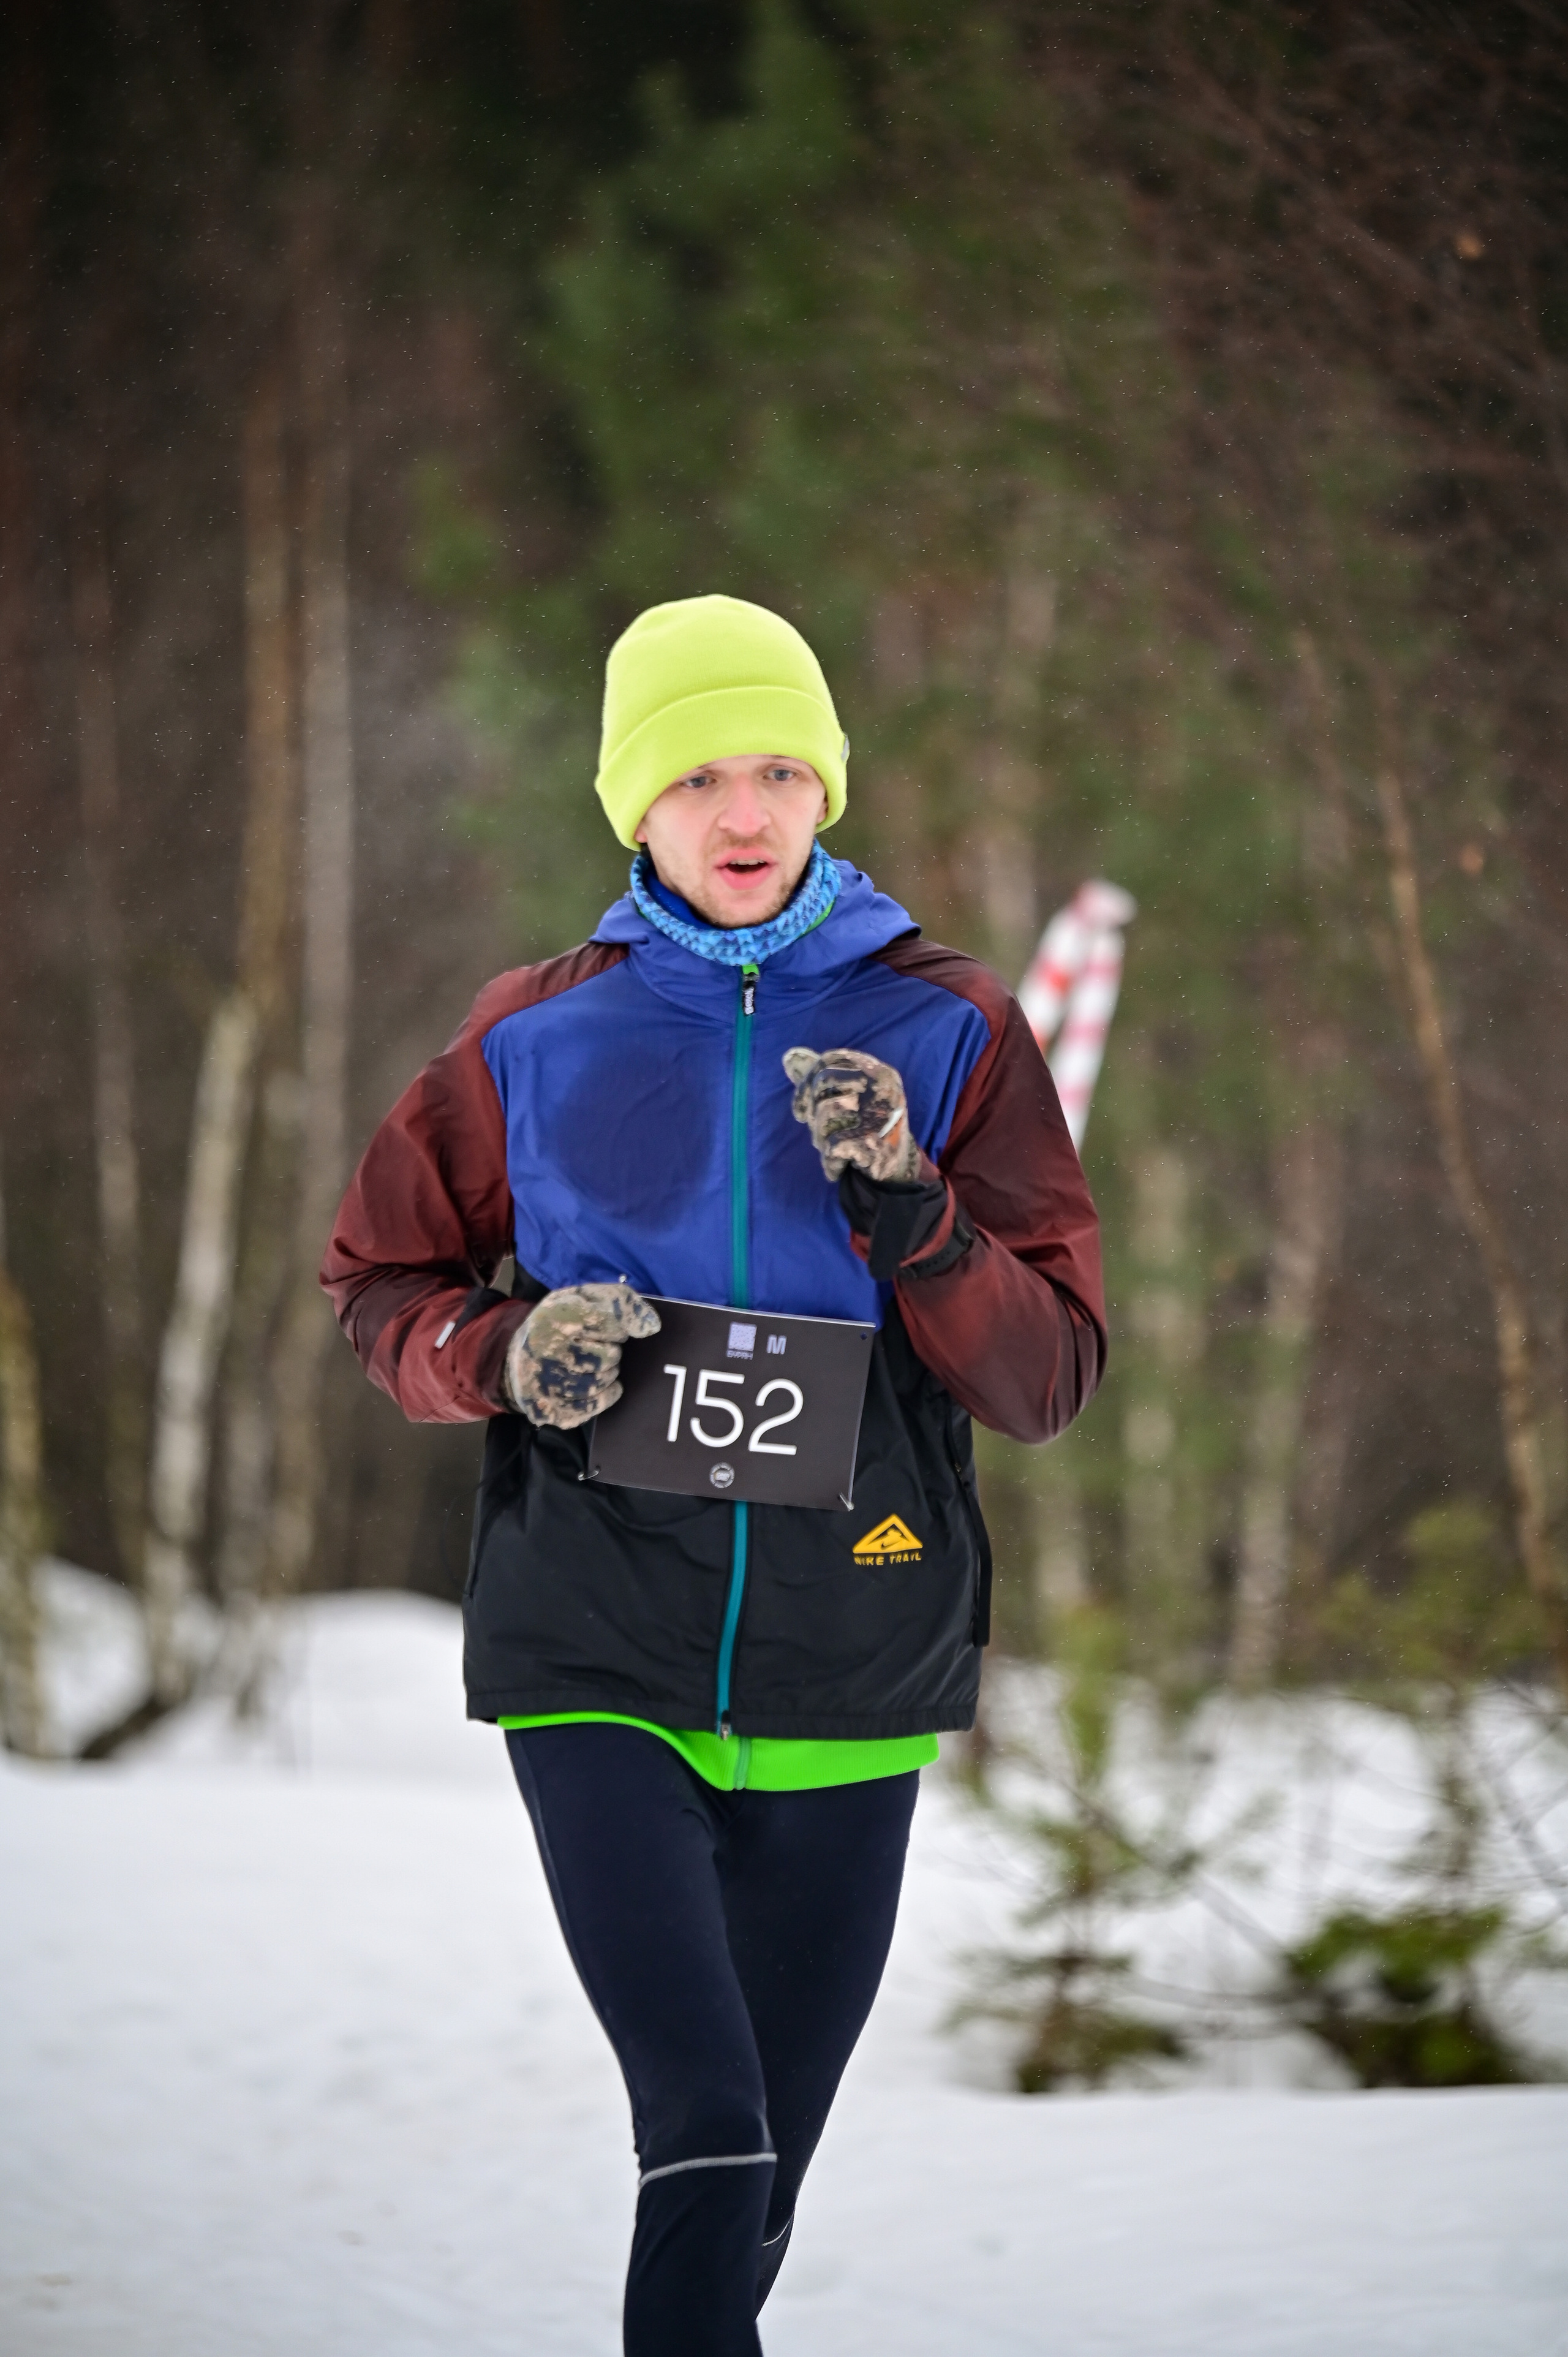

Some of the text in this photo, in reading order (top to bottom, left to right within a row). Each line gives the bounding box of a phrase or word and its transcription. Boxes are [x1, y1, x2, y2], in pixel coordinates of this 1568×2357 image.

[663, 1363, 804, 1455] 152
[854, 1551, 922, 1565] NIKE TRAIL
